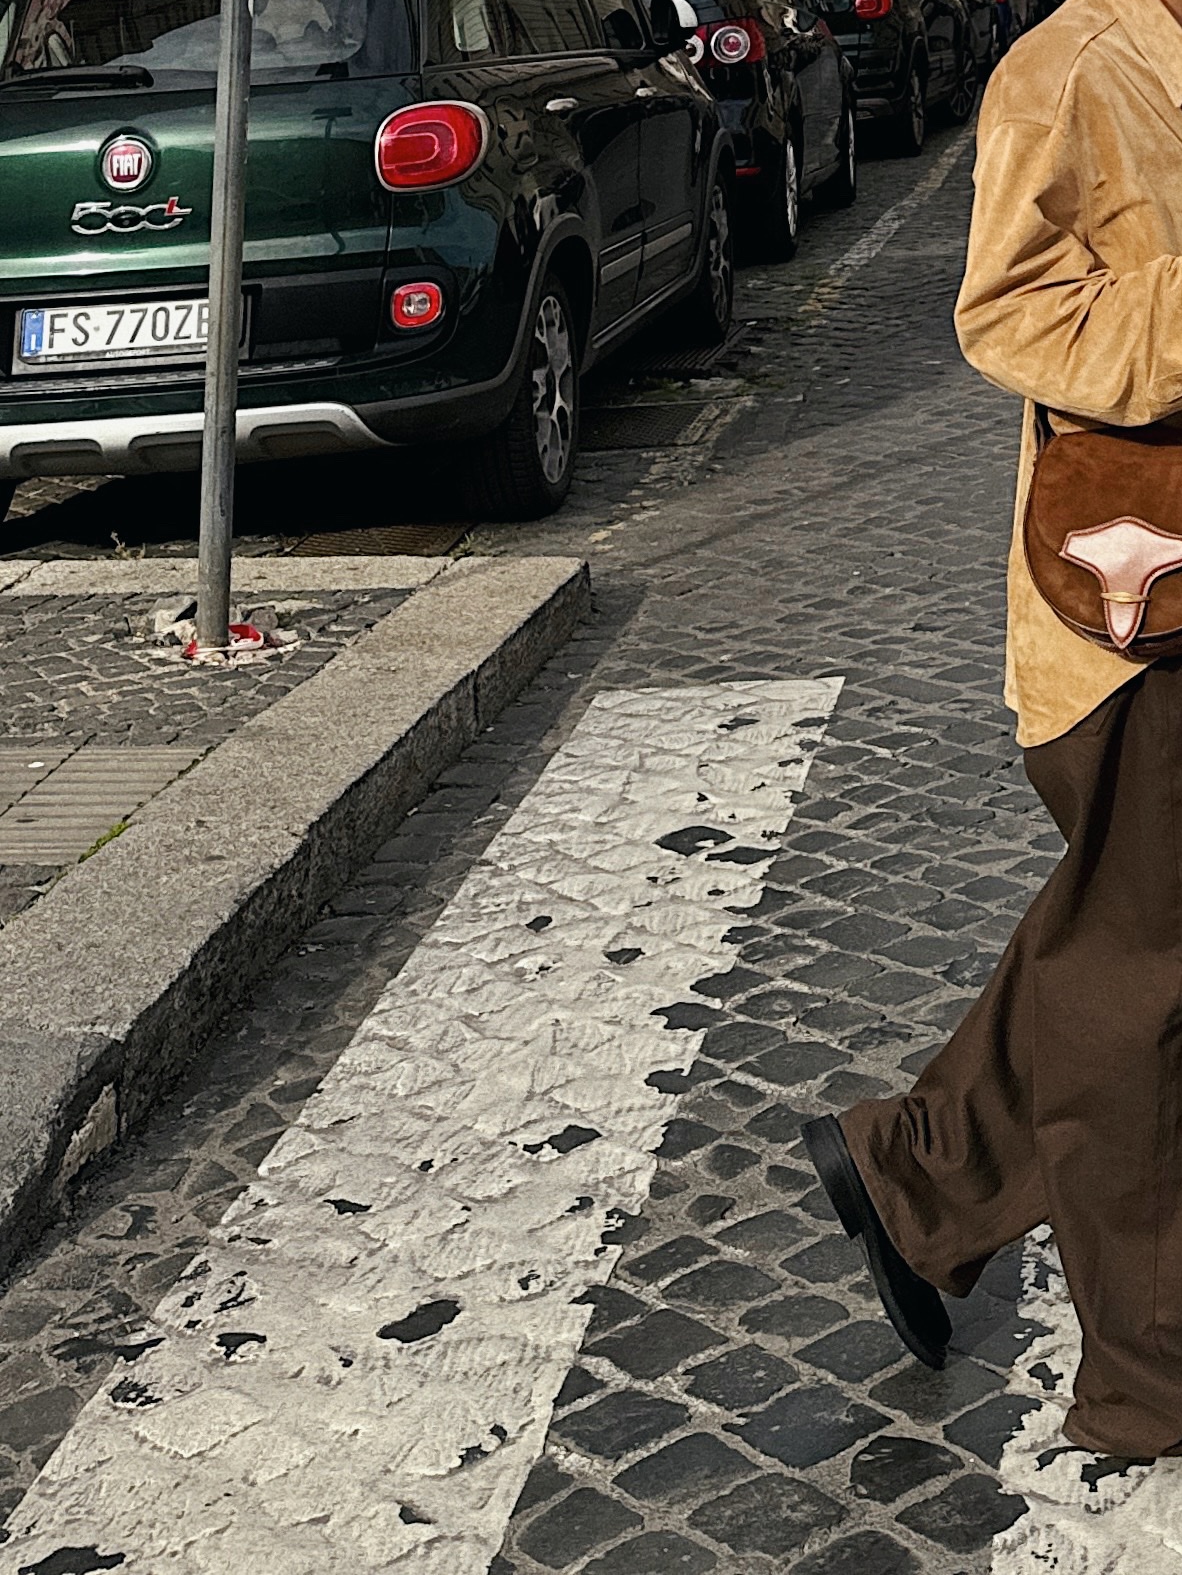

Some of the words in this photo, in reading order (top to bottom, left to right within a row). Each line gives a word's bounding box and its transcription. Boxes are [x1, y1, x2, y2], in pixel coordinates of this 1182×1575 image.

[111, 153, 142, 177] FIAT
[71, 196, 193, 235] 500L
[48, 310, 91, 349] FS
